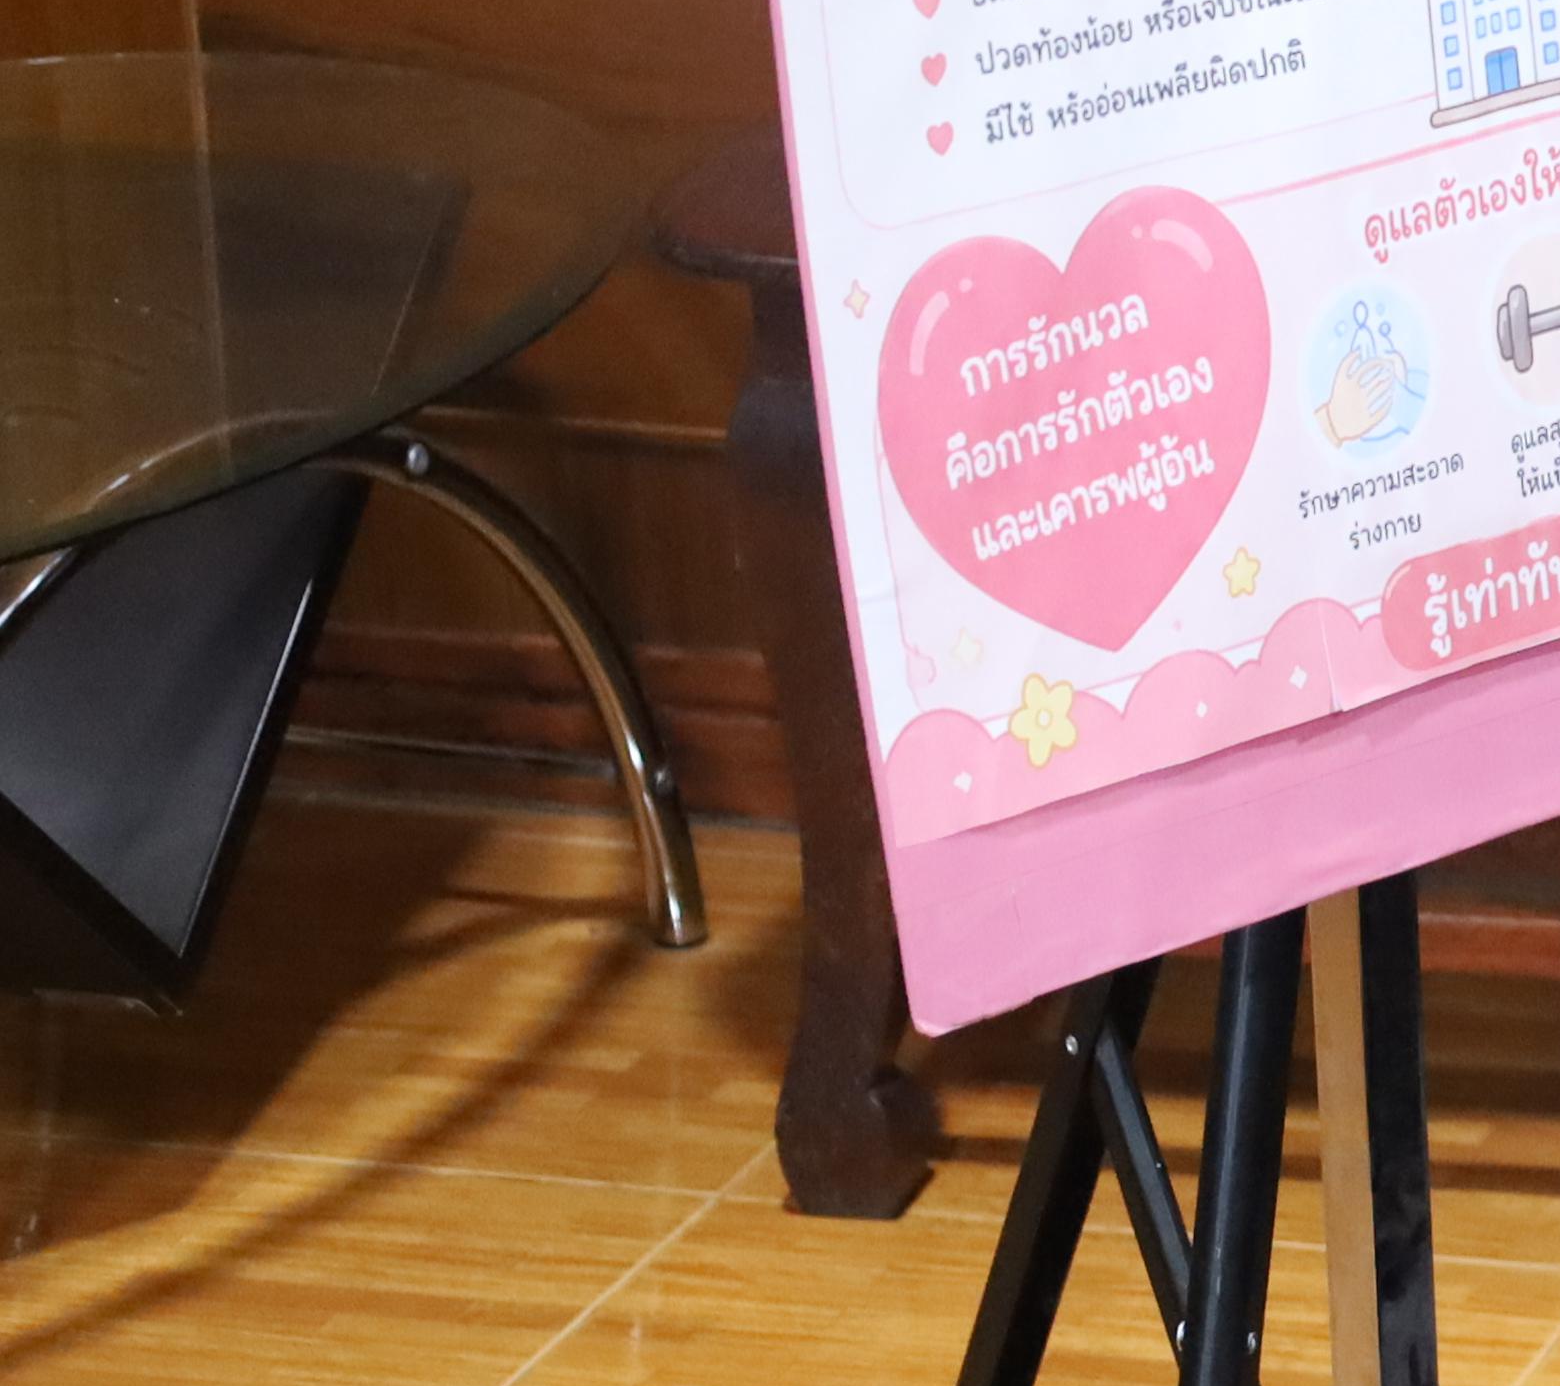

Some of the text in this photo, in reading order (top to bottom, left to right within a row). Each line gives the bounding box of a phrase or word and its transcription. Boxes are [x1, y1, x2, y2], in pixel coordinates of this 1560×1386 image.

[960, 287, 1150, 399] การรักนวล
[1347, 510, 1423, 552] ร่างกาย
